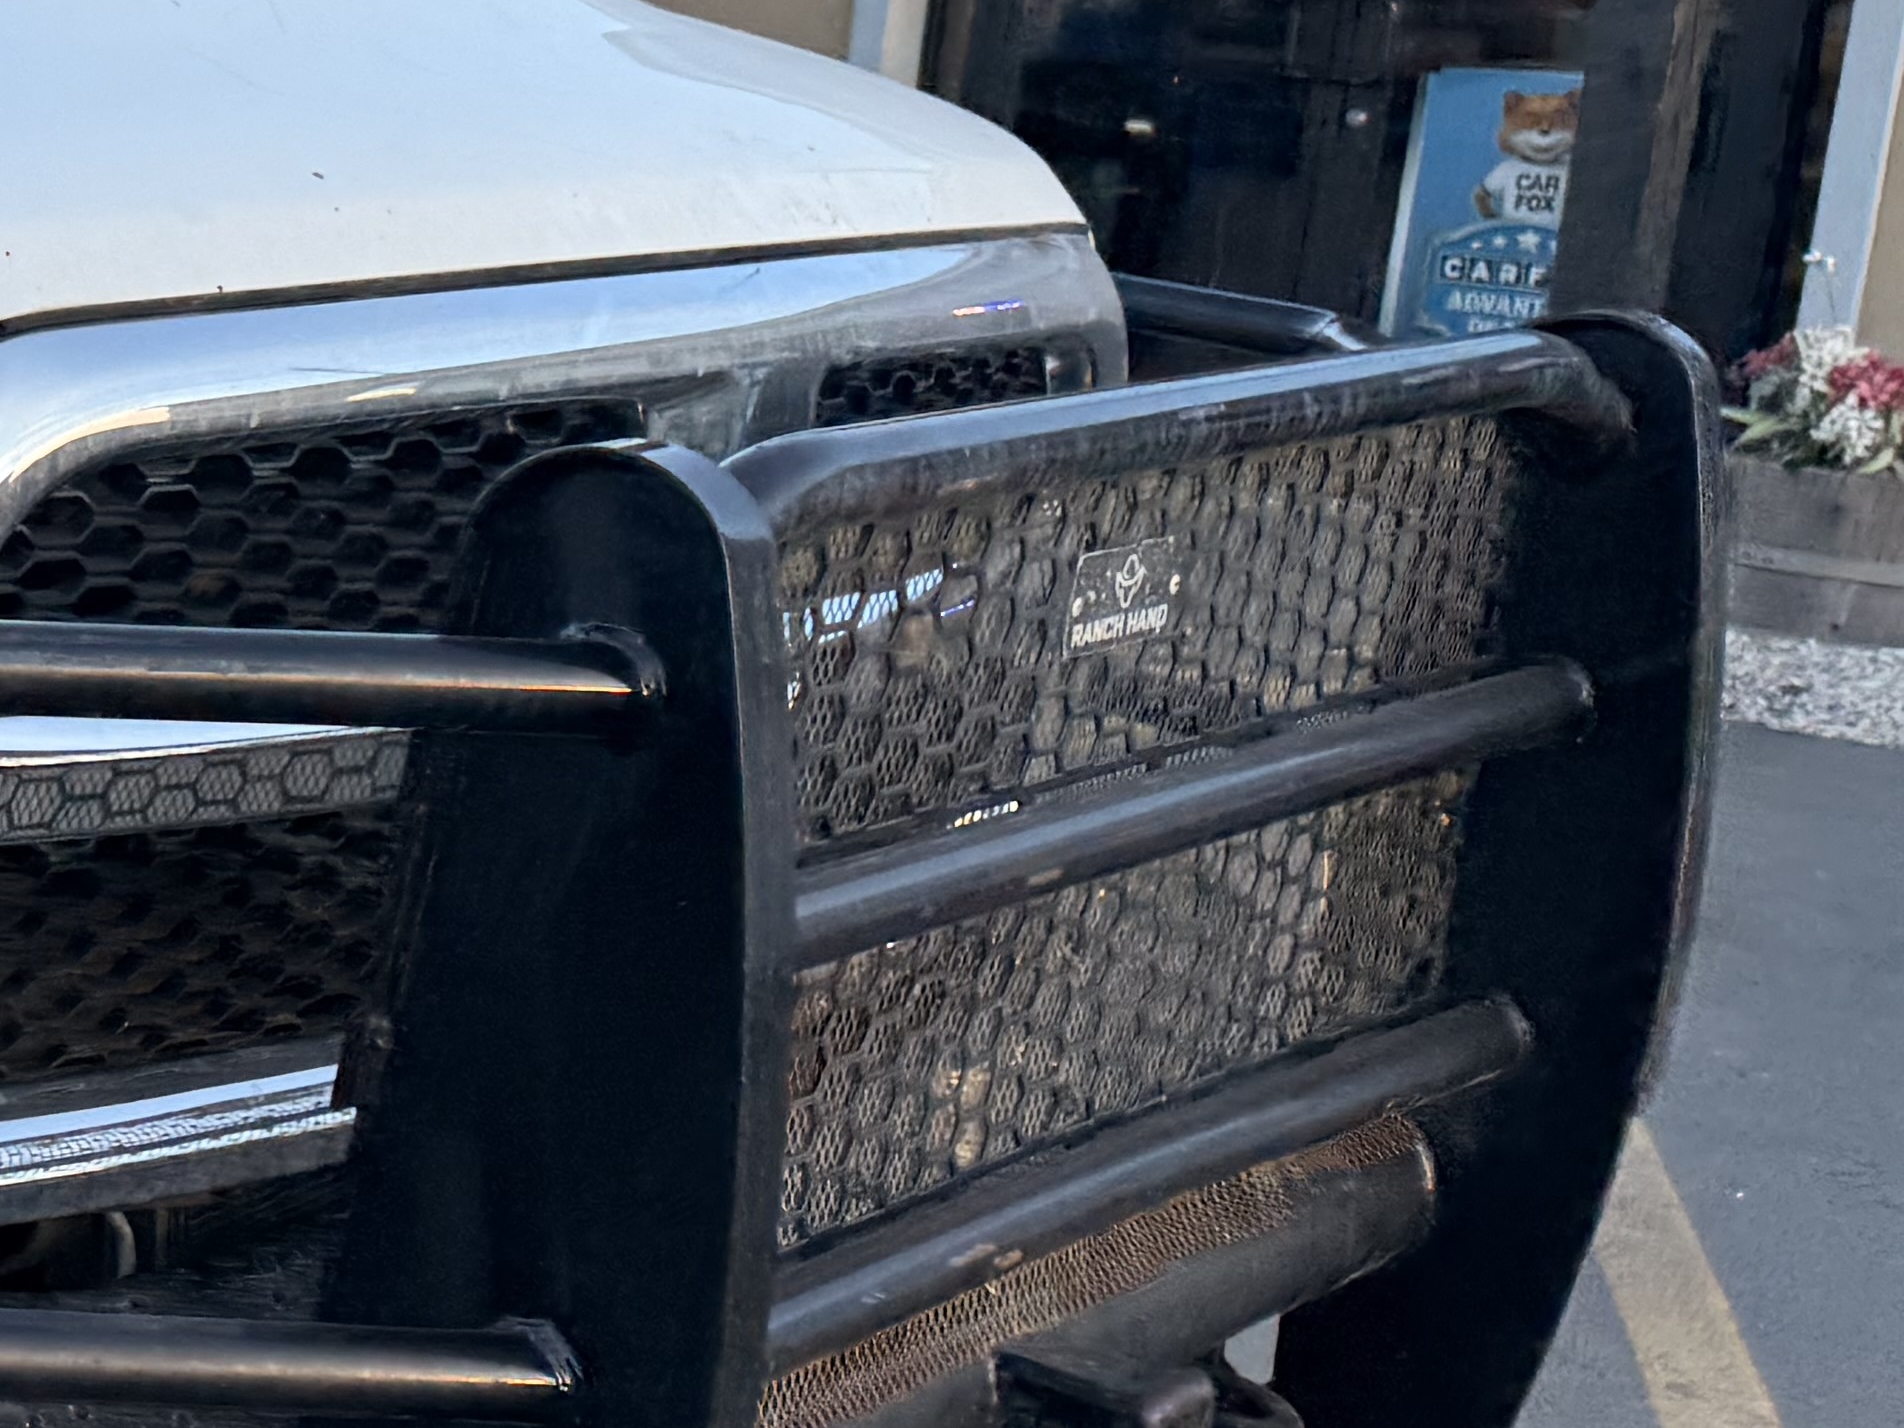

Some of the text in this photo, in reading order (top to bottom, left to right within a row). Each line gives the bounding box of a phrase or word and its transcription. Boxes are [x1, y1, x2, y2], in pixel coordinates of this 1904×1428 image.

[1516, 173, 1559, 193] CAR
[1514, 194, 1556, 212] FOX
[1444, 257, 1547, 287] CARF
[1447, 290, 1545, 318] ADVANT
[1071, 612, 1125, 648] RANCH
